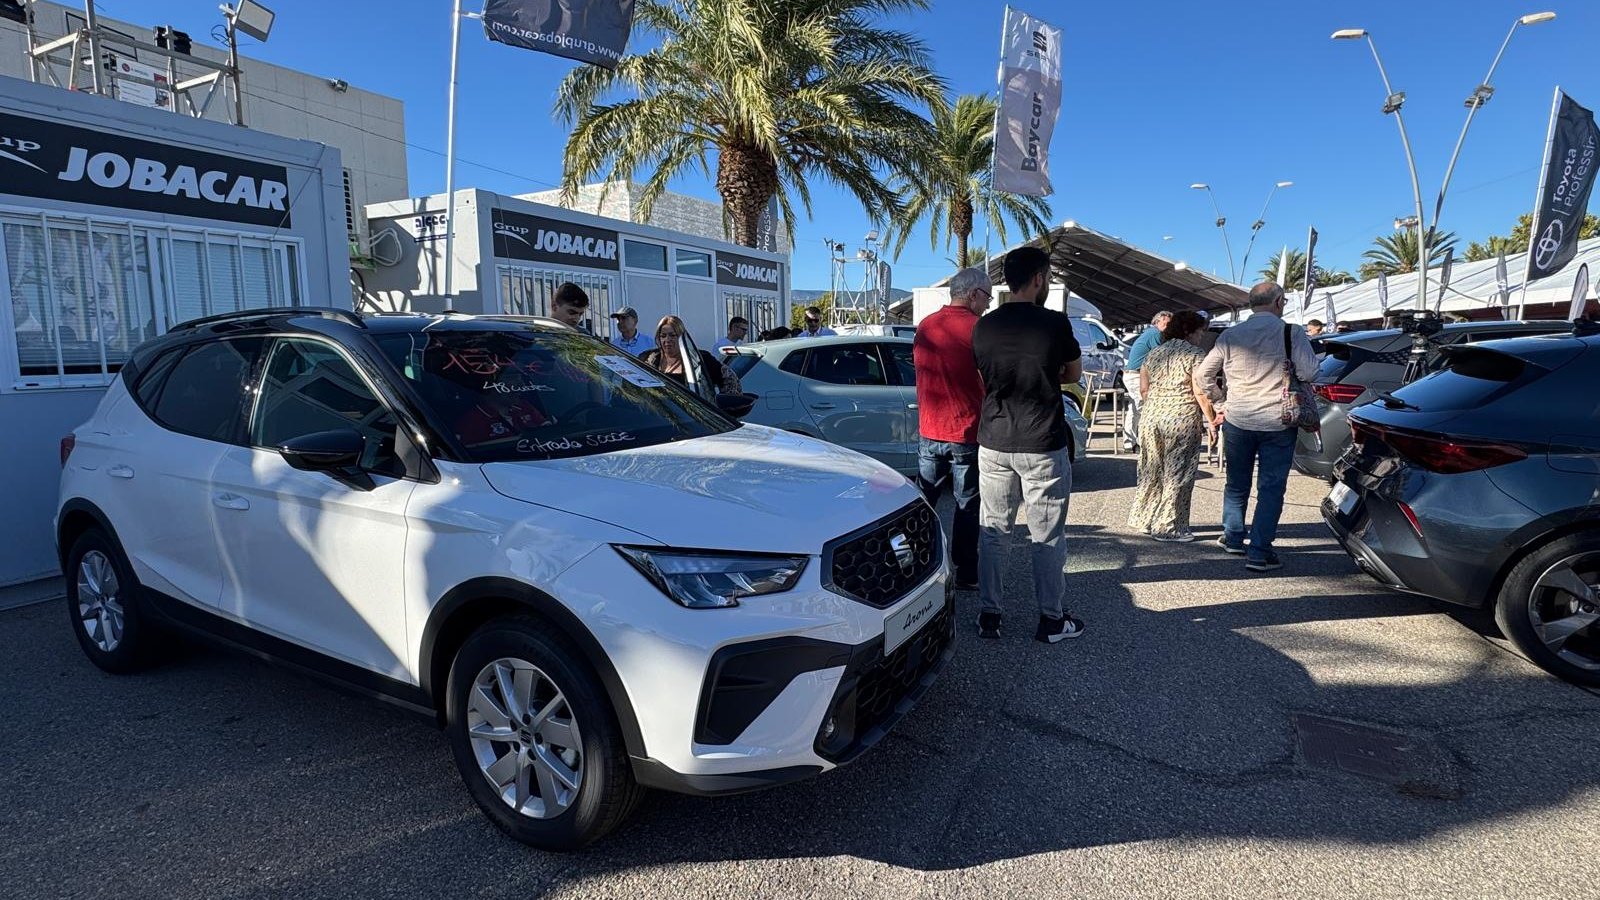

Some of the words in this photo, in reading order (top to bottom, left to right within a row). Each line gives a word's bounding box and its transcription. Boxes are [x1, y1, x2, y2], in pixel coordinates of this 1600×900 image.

[1021, 92, 1043, 172] Baycar
[58, 146, 287, 211] JOBACAR
[1552, 148, 1577, 203] Toyota
[493, 222, 529, 235] Grup
[534, 229, 616, 260] JOBACAR
[736, 263, 777, 283] JOBACAR
[516, 438, 582, 452] Entrada
[903, 600, 933, 630] Arona
